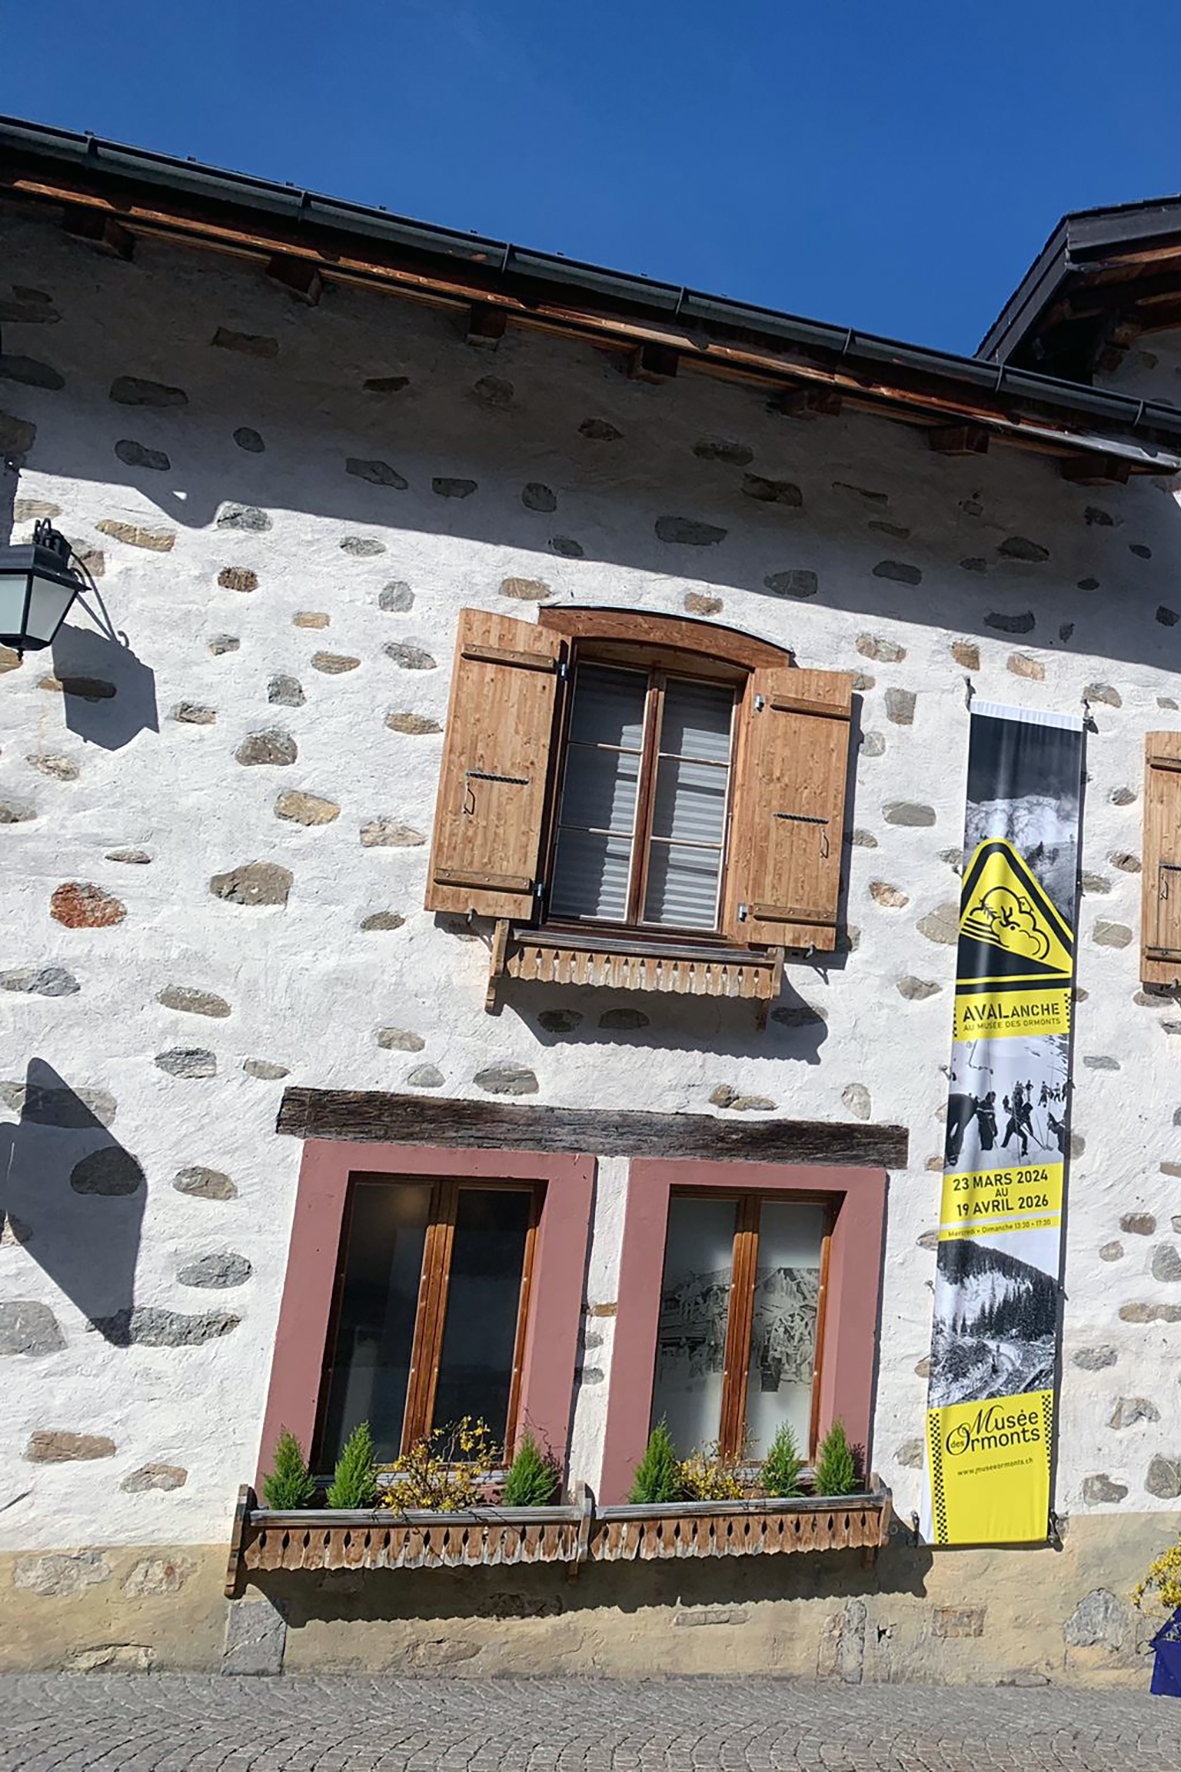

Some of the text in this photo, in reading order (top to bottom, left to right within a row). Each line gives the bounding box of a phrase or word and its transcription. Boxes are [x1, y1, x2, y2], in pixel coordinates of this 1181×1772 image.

[962, 1003, 1060, 1022] AVALANCHE
[1005, 1020, 1021, 1028] DES
[1023, 1017, 1061, 1027] ORMONTS
[953, 1169, 1048, 1191] 23 MARS 2024
[995, 1188, 1008, 1198] AU
[957, 1194, 1049, 1216] 19 AVRIL 2026
[981, 1224, 1013, 1233] Dimanche
[957, 1405, 1038, 1438] Musée
[946, 1427, 1040, 1455] Ormonts
[951, 1440, 965, 1448] des
